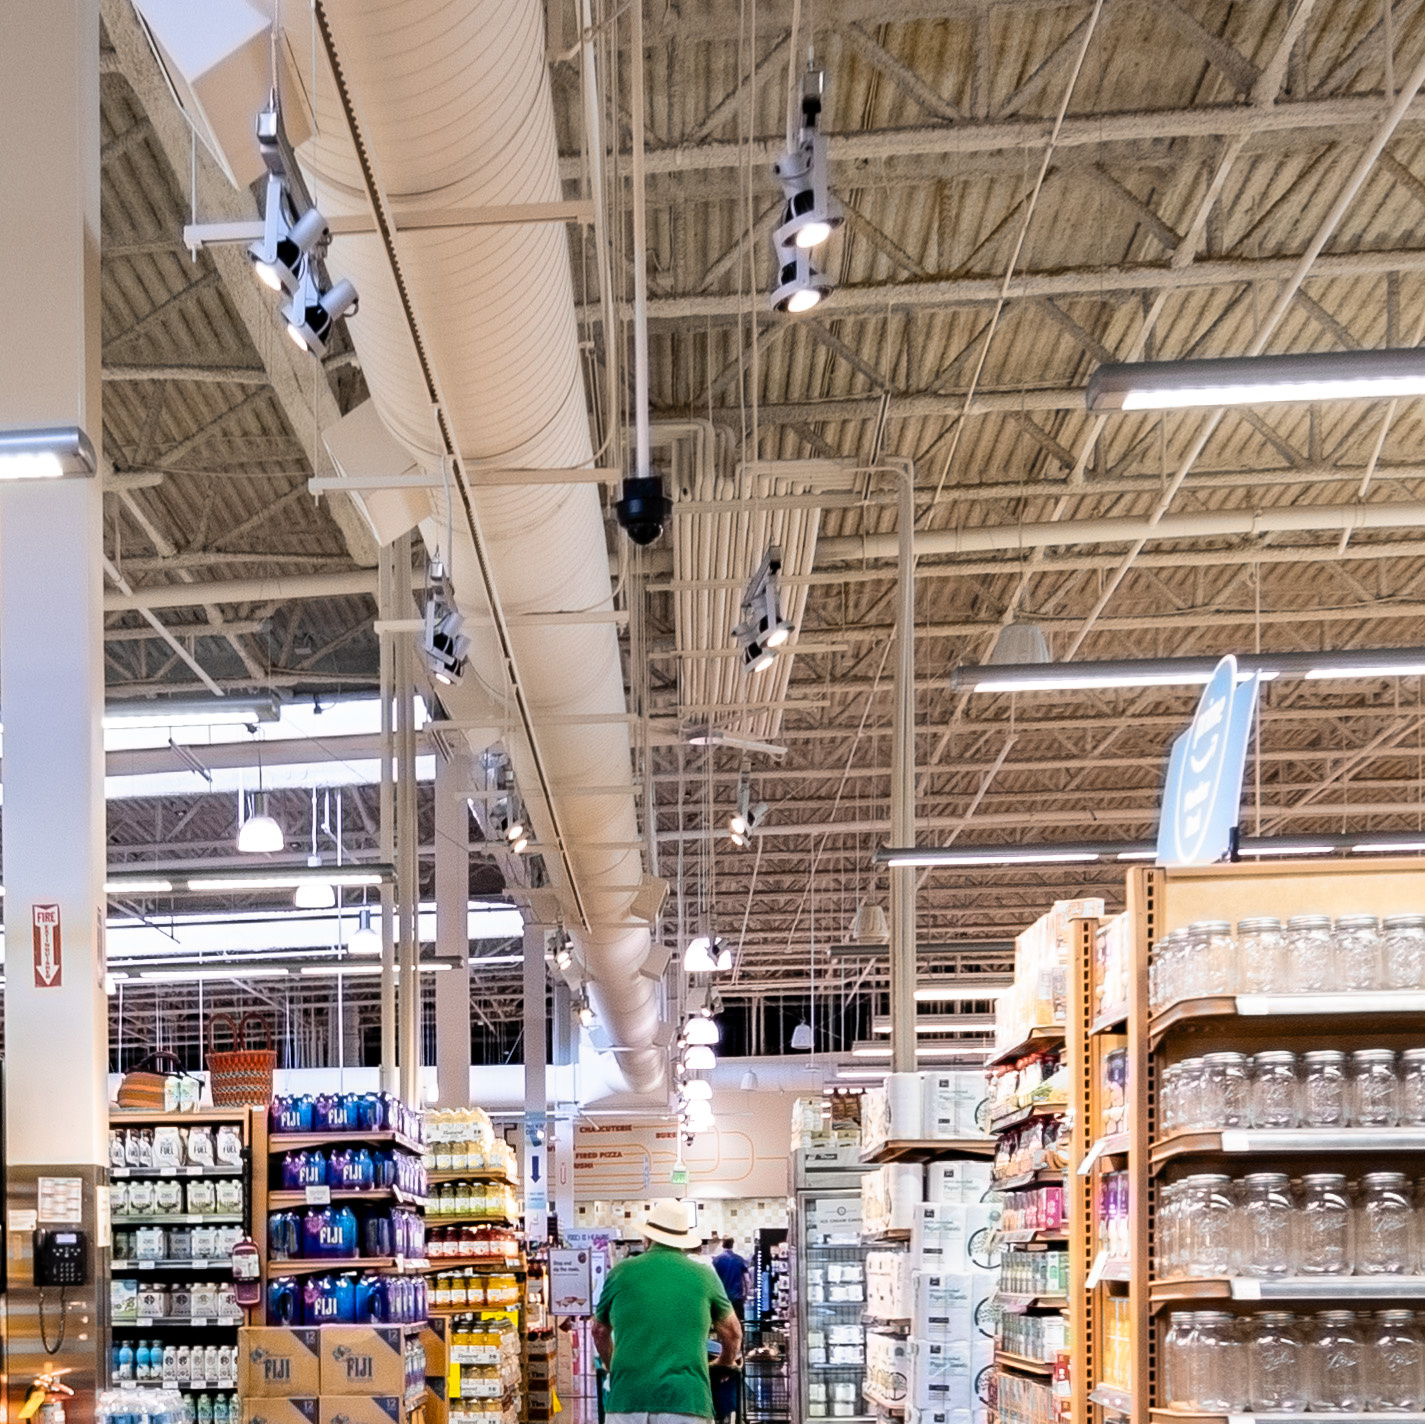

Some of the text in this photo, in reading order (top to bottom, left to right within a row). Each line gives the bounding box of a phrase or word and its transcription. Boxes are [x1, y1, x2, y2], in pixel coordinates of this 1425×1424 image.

[37, 911, 56, 923] FIRE
[282, 1112, 300, 1127] FIJI
[328, 1109, 347, 1124] FIJI
[300, 1167, 318, 1182] FIJI
[343, 1165, 362, 1180] FIJI
[320, 1227, 343, 1244] FIJI
[314, 1298, 337, 1315] FIJI
[305, 1331, 315, 1339] 12
[388, 1330, 398, 1339] 12
[265, 1359, 290, 1379] FIJI
[347, 1357, 372, 1377] FIJI
[304, 1400, 314, 1409] 12
[387, 1398, 396, 1407] 12
